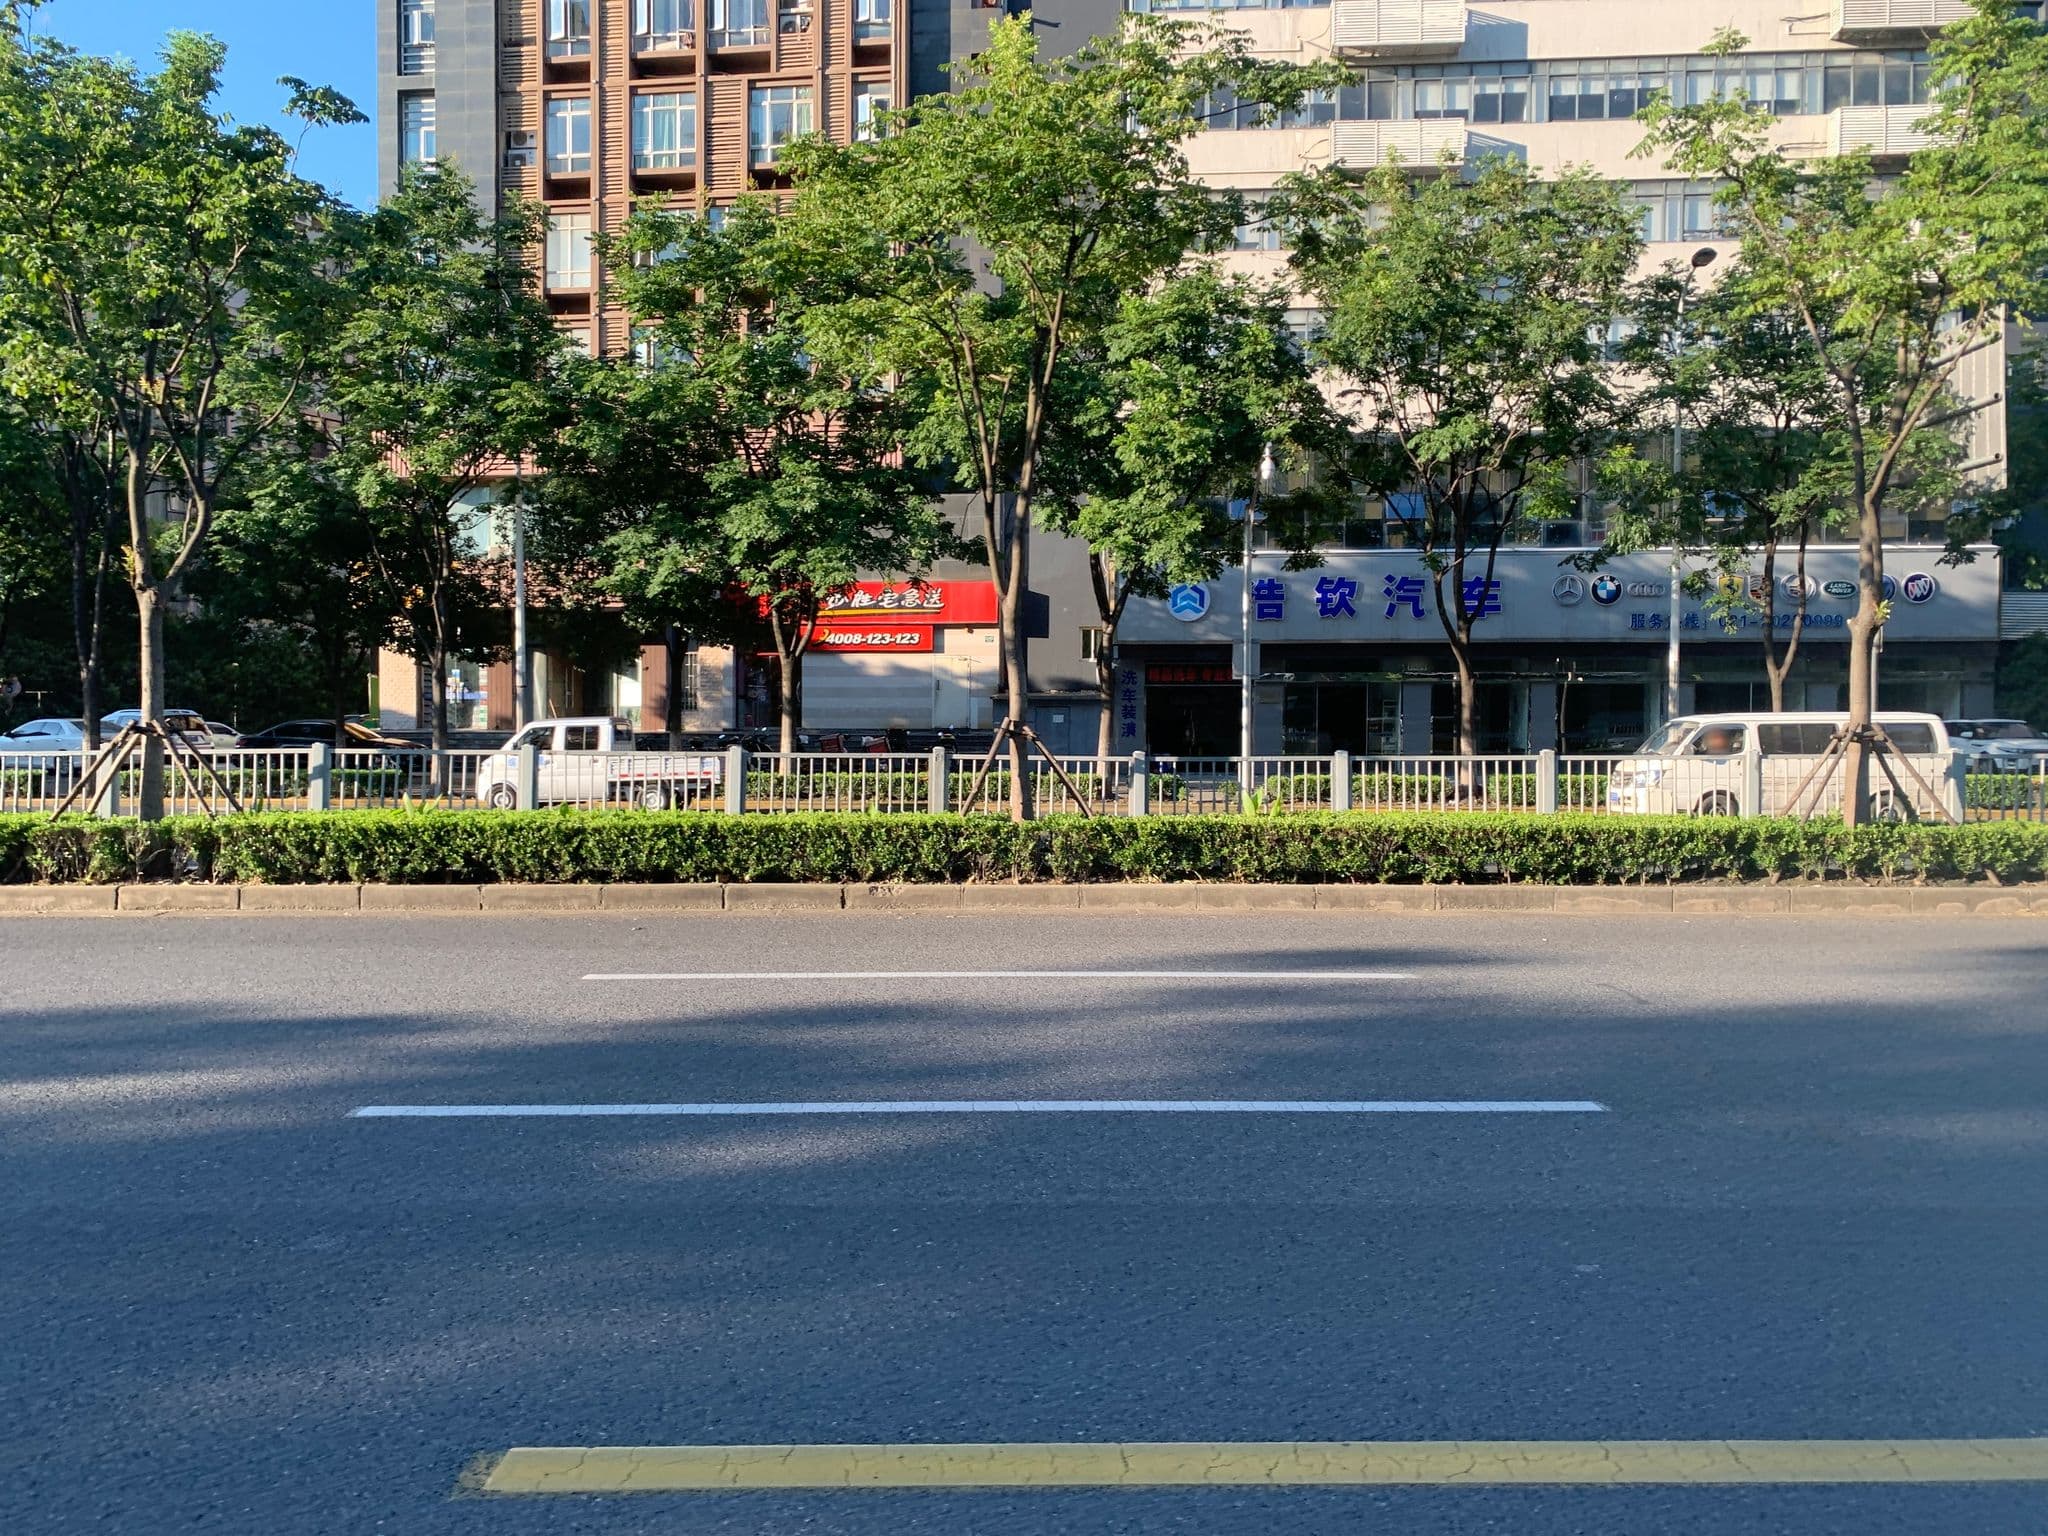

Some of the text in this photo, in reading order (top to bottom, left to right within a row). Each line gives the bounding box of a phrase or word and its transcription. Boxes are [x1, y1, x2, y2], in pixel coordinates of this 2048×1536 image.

[825, 588, 945, 610] 必胜宅急送
[827, 632, 920, 645] 4008-123-123
